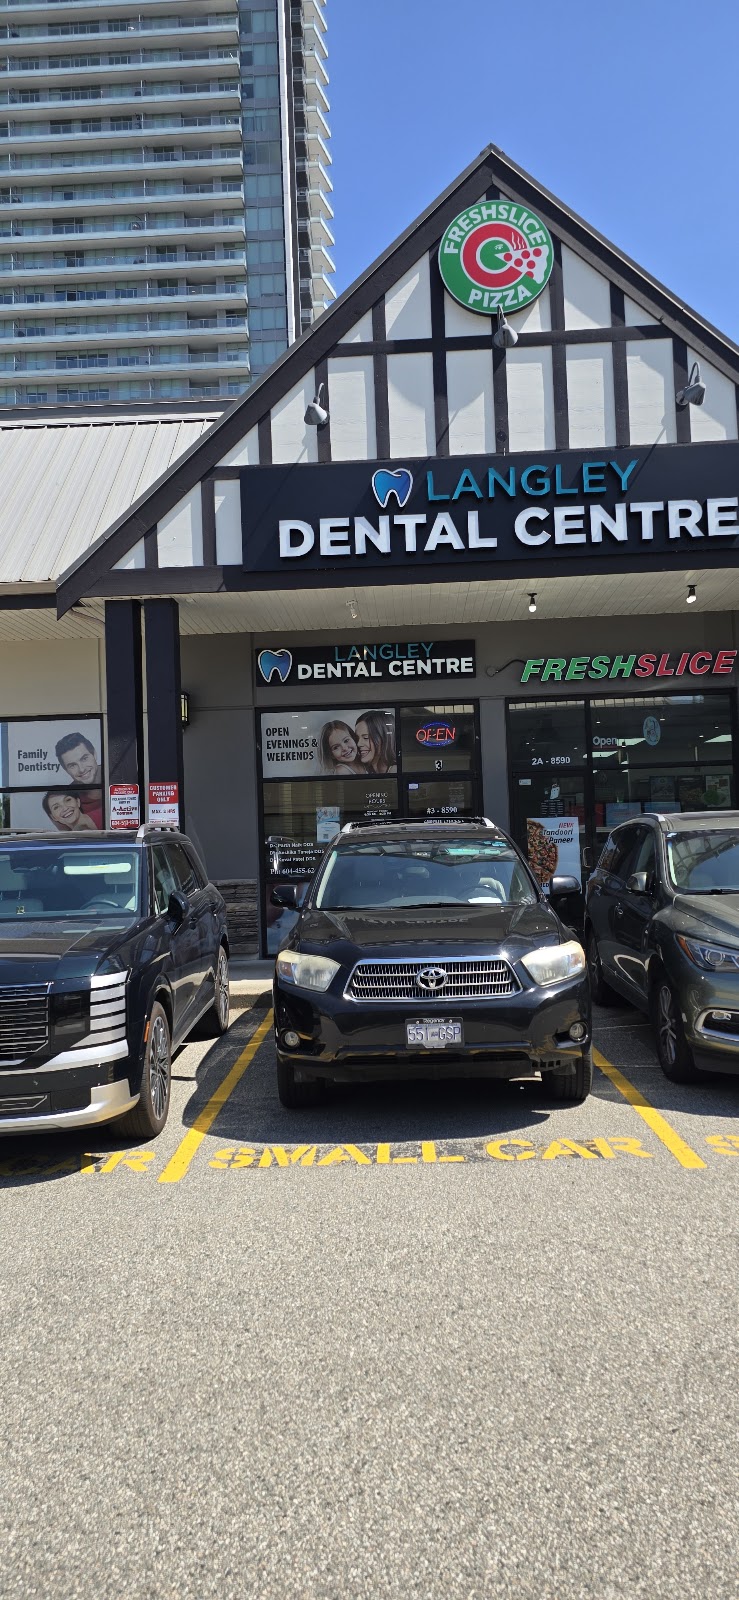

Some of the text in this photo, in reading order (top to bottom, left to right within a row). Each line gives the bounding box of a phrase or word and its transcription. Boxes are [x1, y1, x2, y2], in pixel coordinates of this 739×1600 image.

[444, 204, 547, 254] FRESHSLICE
[468, 284, 533, 308] PIZZA
[427, 459, 639, 501] LANGLEY
[278, 497, 739, 558] DENTAL CENTRE
[334, 642, 434, 662] LANGLEY
[297, 657, 474, 680] DENTAL CENTRE
[520, 650, 738, 682] FRESHSLICE
[265, 727, 289, 737] OPEN
[416, 727, 456, 742] OPEN
[266, 738, 318, 750] EVENINGS &
[592, 736, 617, 748] Open
[17, 749, 48, 761] Family
[266, 751, 315, 762] WEEKENDS
[531, 757, 543, 766] 2A
[550, 756, 571, 765] 8590
[18, 761, 61, 773] Dentistry
[435, 760, 443, 771] 3
[441, 806, 458, 814] 8590
[543, 828, 574, 836] Tandoori
[408, 1025, 461, 1041] 551 GSP
[209, 1136, 653, 1169] SMALL CAR
